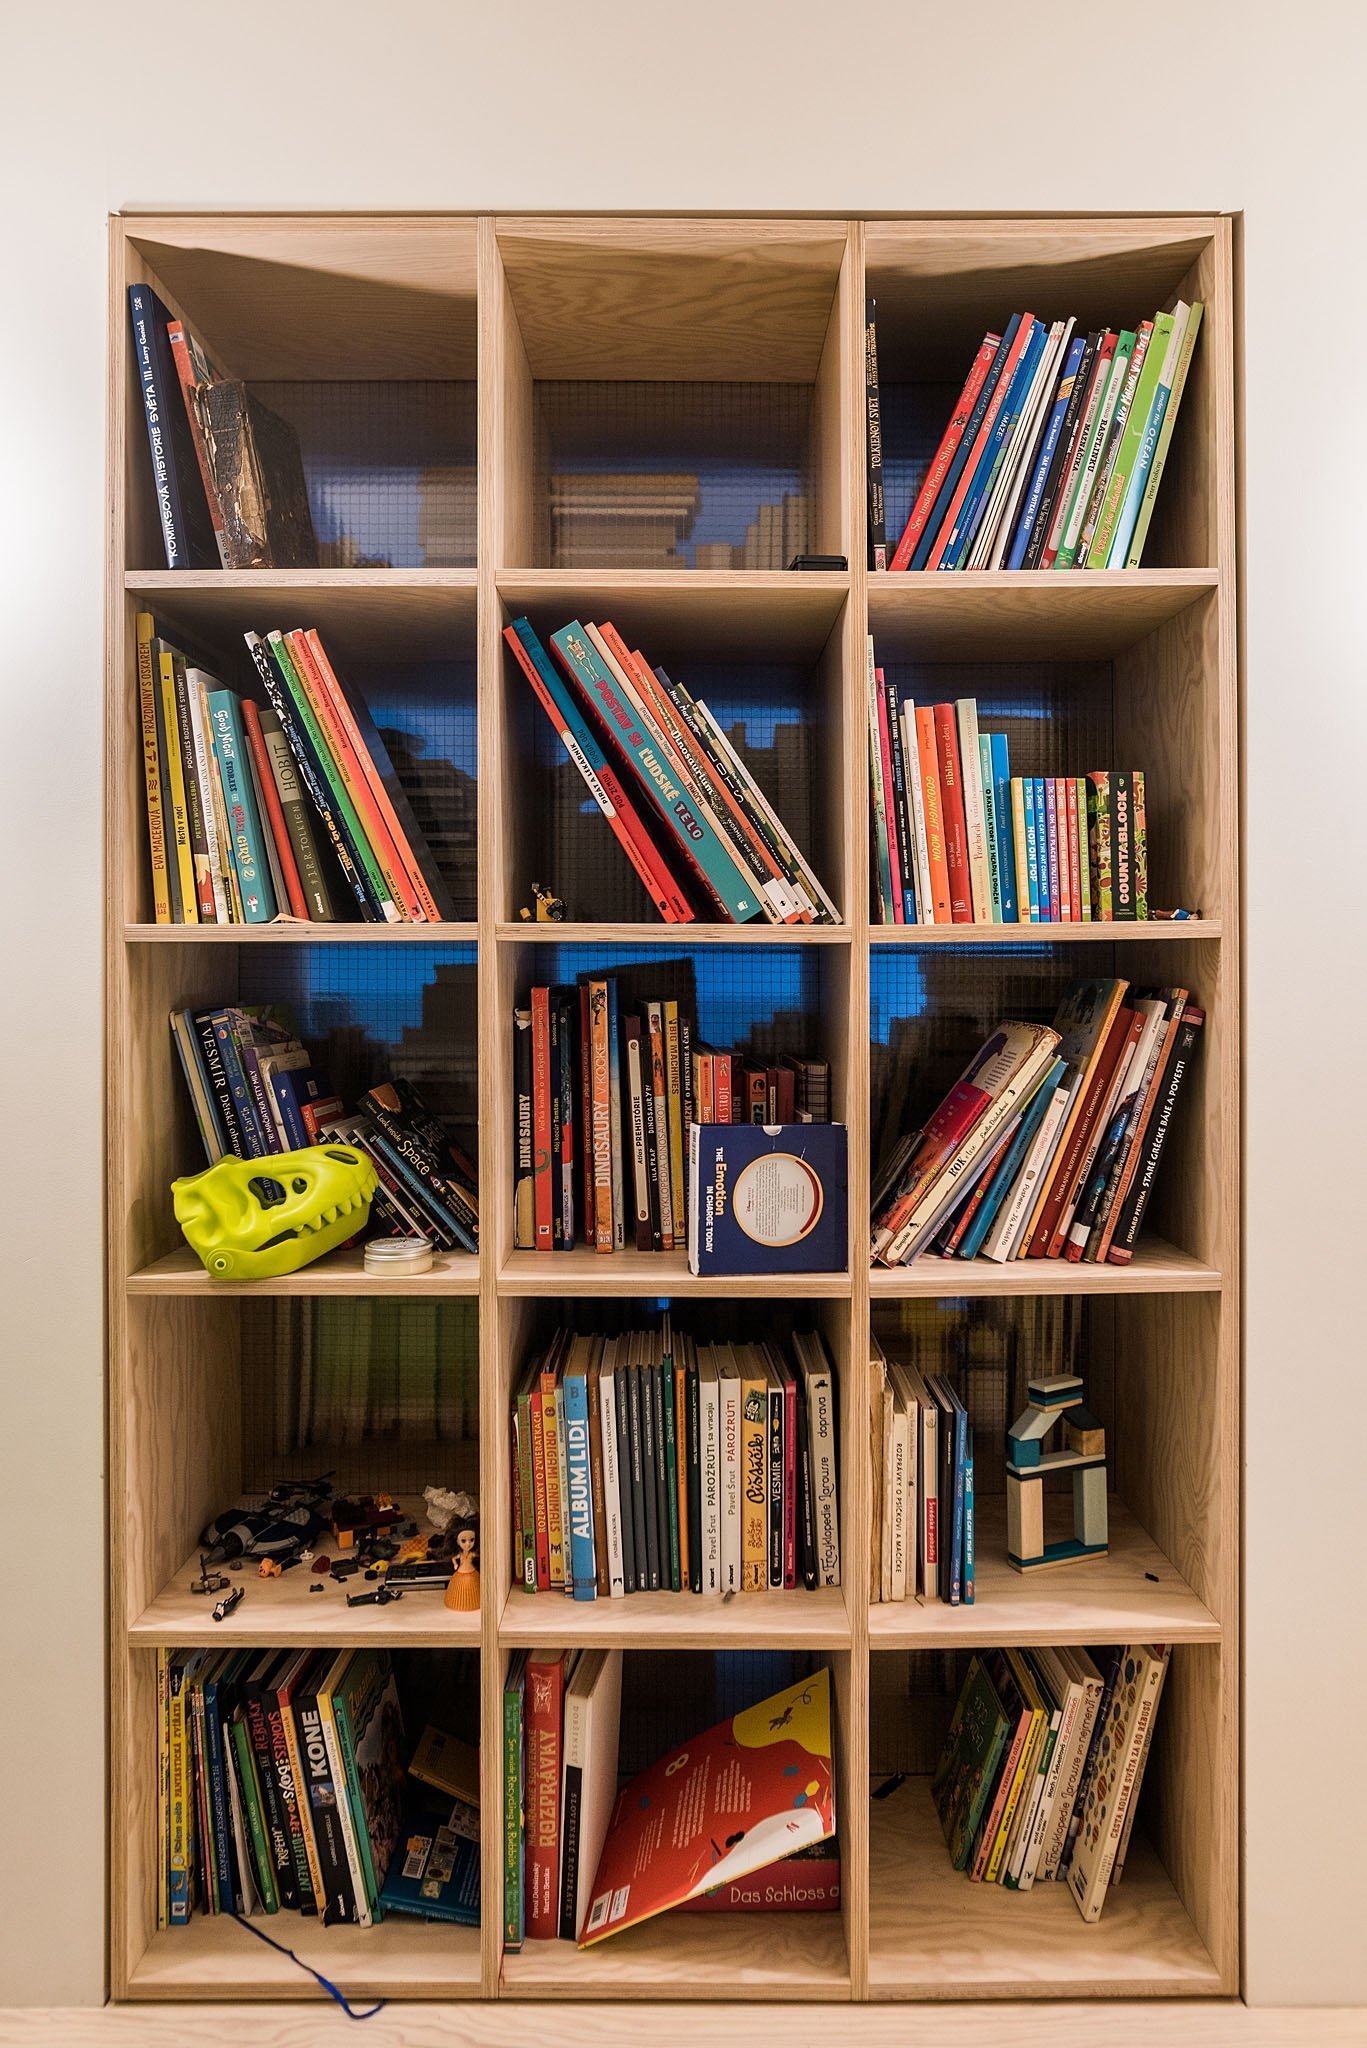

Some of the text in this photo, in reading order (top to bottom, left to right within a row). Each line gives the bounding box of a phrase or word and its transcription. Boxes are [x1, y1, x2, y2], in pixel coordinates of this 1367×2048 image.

[869, 396, 878, 416] SVET
[1138, 391, 1165, 468] under the OCEAN
[152, 428, 165, 481] HISTORIE
[1086, 419, 1107, 472] RASTLINKU
[910, 436, 955, 531] See inside Pirate Ships
[139, 642, 150, 678] OSKAREM
[142, 688, 154, 733] PRÁZDNINY
[195, 733, 204, 752] WHAT
[273, 742, 295, 790] HOBIT
[594, 679, 633, 730] POSTAV
[627, 730, 644, 747] SI
[673, 801, 704, 841] TELO
[670, 729, 715, 794] Dinosaurium
[941, 724, 953, 785] Biblia pre deti
[149, 809, 162, 851] MACEKOVÁ
[176, 827, 185, 844] Mesto
[189, 780, 201, 838] PETER WOHLLEBEN
[925, 775, 941, 862] GOODNIGHT MOON
[1027, 827, 1035, 844] HOP
[152, 854, 163, 869] EVA
[1117, 791, 1128, 902] COUNTABLOCK
[200, 1027, 235, 1126] VESMÍR Dětská
[595, 1043, 605, 1082] KOCKE
[669, 1027, 679, 1093] BIG MACHINES
[376, 1112, 432, 1177] Look inside Space
[594, 1100, 610, 1186] DINOSAURY
[1140, 1160, 1155, 1187] STARÉ
[1148, 1126, 1166, 1159] GRÉCKE
[1158, 1105, 1172, 1125] BÁJE
[1169, 1060, 1185, 1095] POVESTI
[715, 1164, 726, 1214] Emotion
[1126, 1215, 1139, 1242] EDUARD
[725, 1400, 734, 1460] PÁROŽRÚTI
[546, 1430, 559, 1531] ORIGAMI ANIMALS
[568, 1419, 589, 1538] ALBUM LIDÍ
[705, 1444, 715, 1504] PÁROŽRÚTI
[726, 1470, 734, 1488] Šrut
[771, 1461, 780, 1500] VESMÍR
[816, 1397, 835, 1570] Encyklopedie Larousse doprava
[707, 1515, 715, 1533] Šrut
[301, 1709, 327, 1776] KONE
[506, 1776, 516, 1818] Recycling
[536, 1730, 557, 1846] ROZPRÁVKY
[507, 1832, 516, 1866] Rubbish
[1044, 1801, 1071, 1866] Encyklopedie
[730, 1881, 824, 1903] Das Schloss
